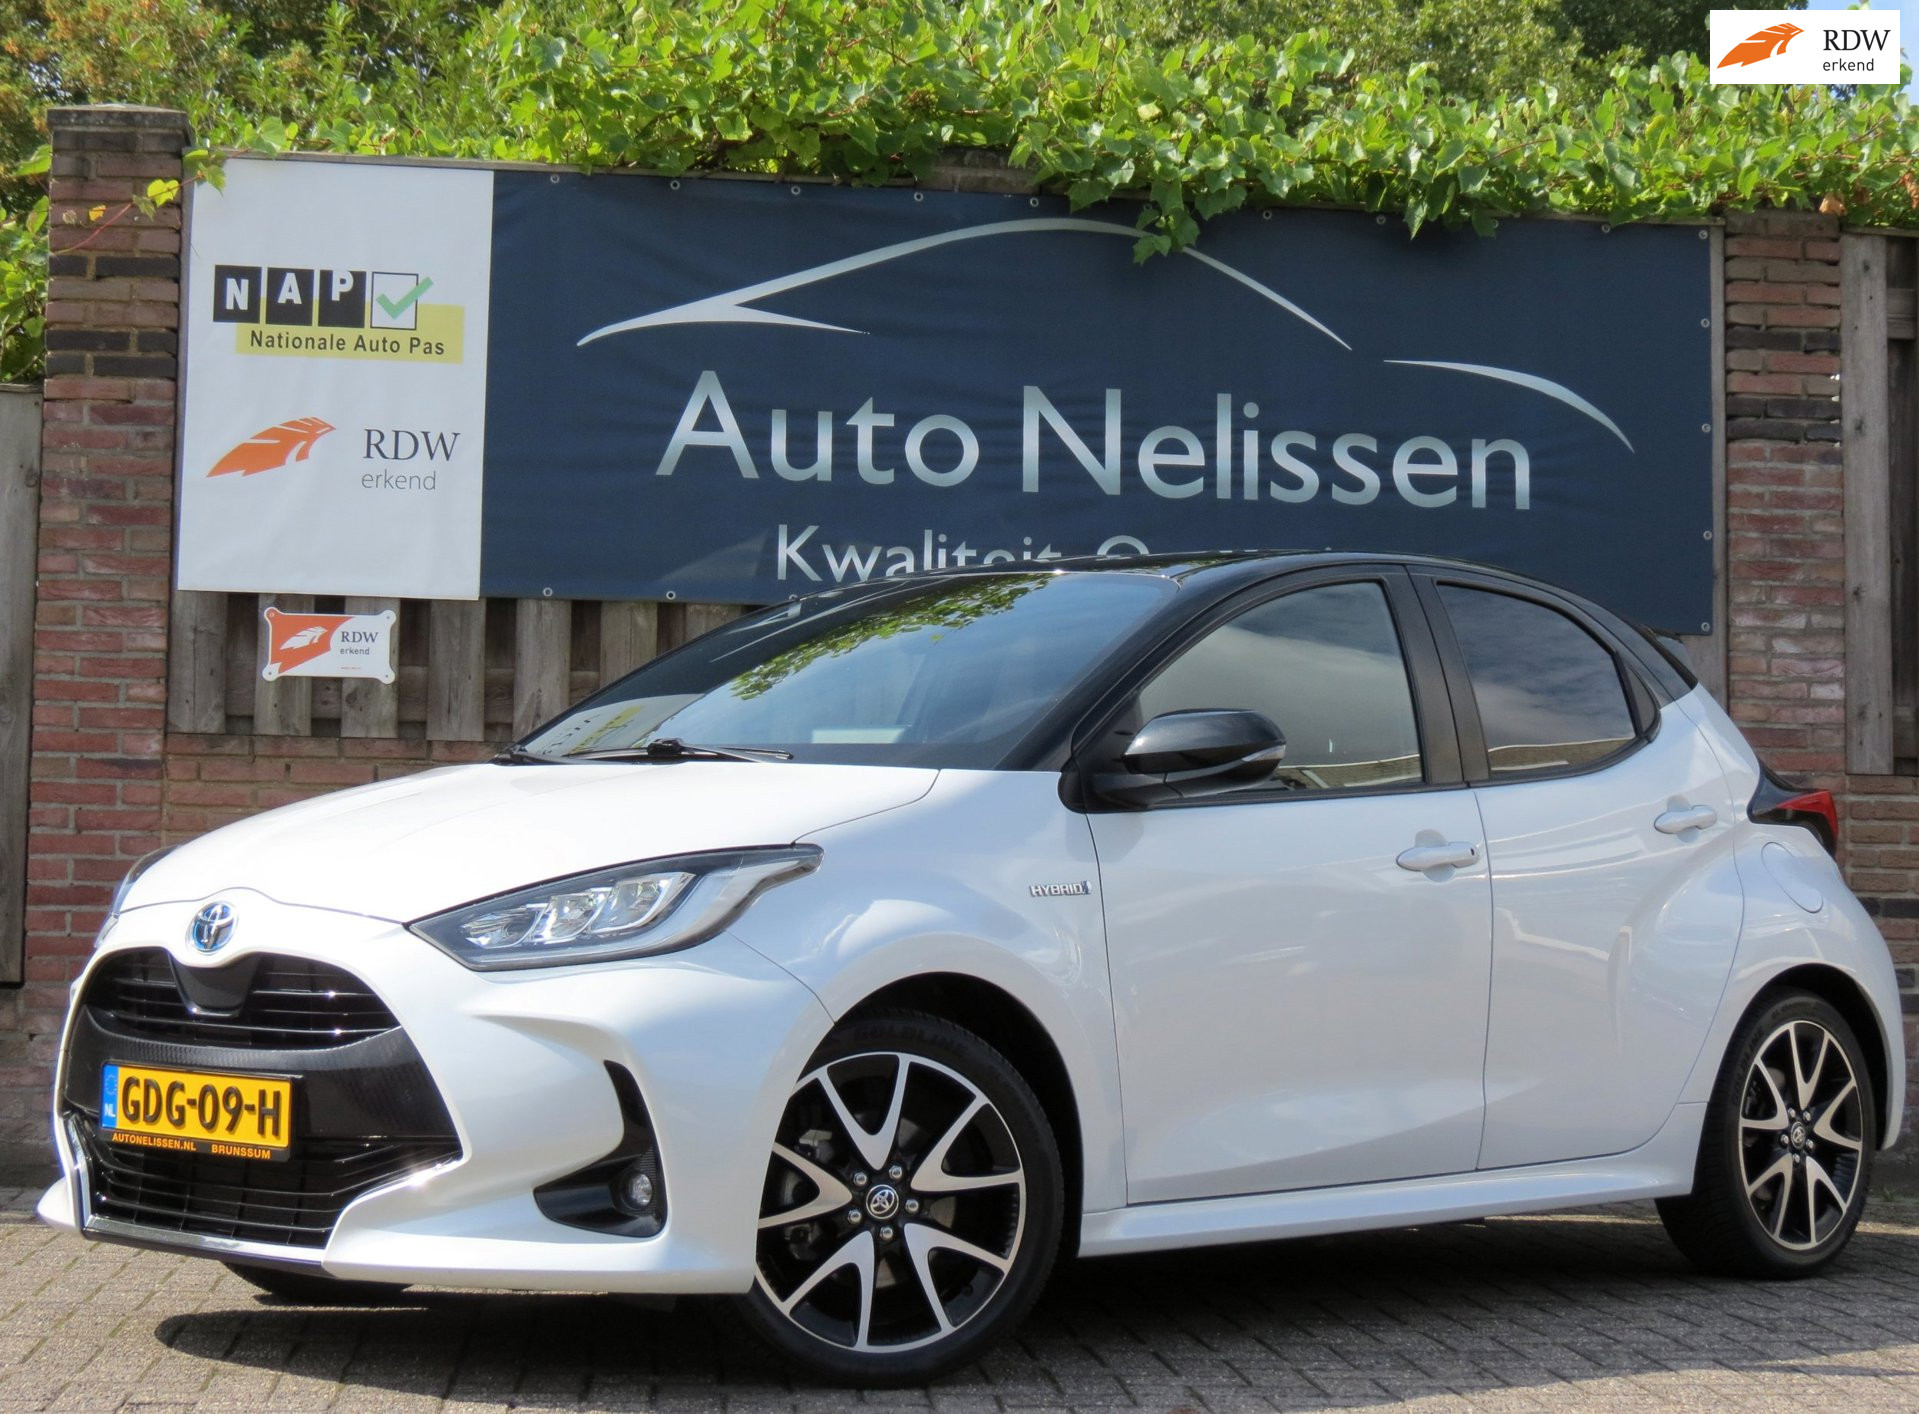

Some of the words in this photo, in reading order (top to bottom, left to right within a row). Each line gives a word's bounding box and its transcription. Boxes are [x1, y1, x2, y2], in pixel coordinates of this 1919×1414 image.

[224, 270, 355, 312] NAP
[250, 329, 346, 352] Nationale
[354, 334, 401, 354] Auto
[409, 337, 445, 356] Pas
[363, 428, 461, 462] RDW
[656, 370, 980, 488] Auto
[1022, 385, 1531, 510] Nelissen
[361, 468, 437, 491] erkend
[341, 631, 379, 643] RDW
[340, 647, 370, 656] erkend
[1029, 883, 1084, 897] HYBRID
[104, 1103, 116, 1118] NL
[122, 1076, 281, 1137] GDG-09-H
[112, 1132, 197, 1152] AUTONELISSEN.NL
[211, 1143, 271, 1160] BRUNSSUM
